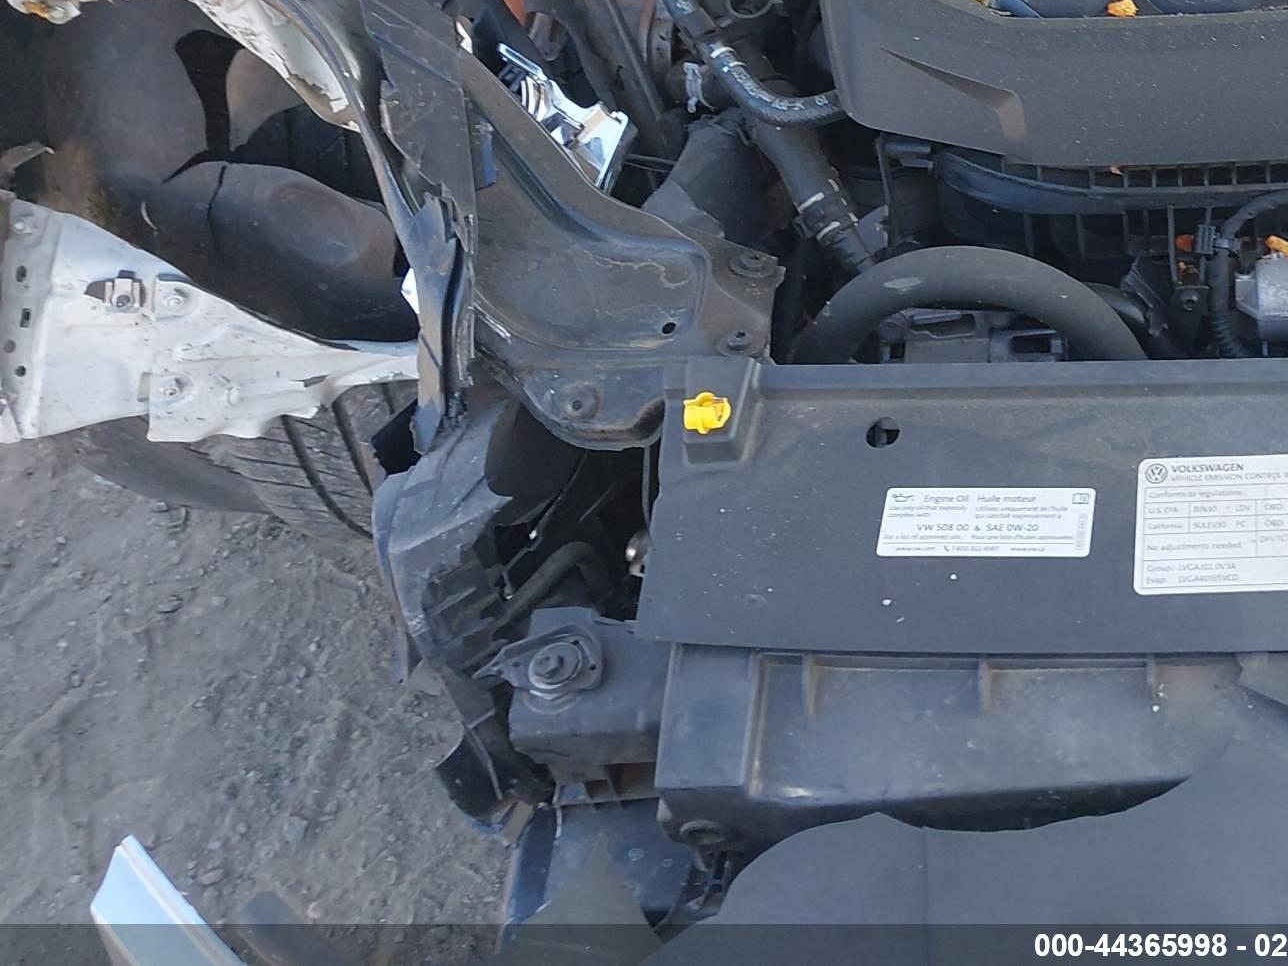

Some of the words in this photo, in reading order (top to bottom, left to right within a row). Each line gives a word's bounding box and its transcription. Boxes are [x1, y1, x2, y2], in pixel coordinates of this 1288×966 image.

[1171, 463, 1244, 473] VOLKSWAGEN
[1171, 474, 1202, 482] VEHICLE
[1245, 472, 1281, 480] CONTROL
[924, 495, 954, 504] Engine
[1006, 523, 1039, 531] 0W-20
